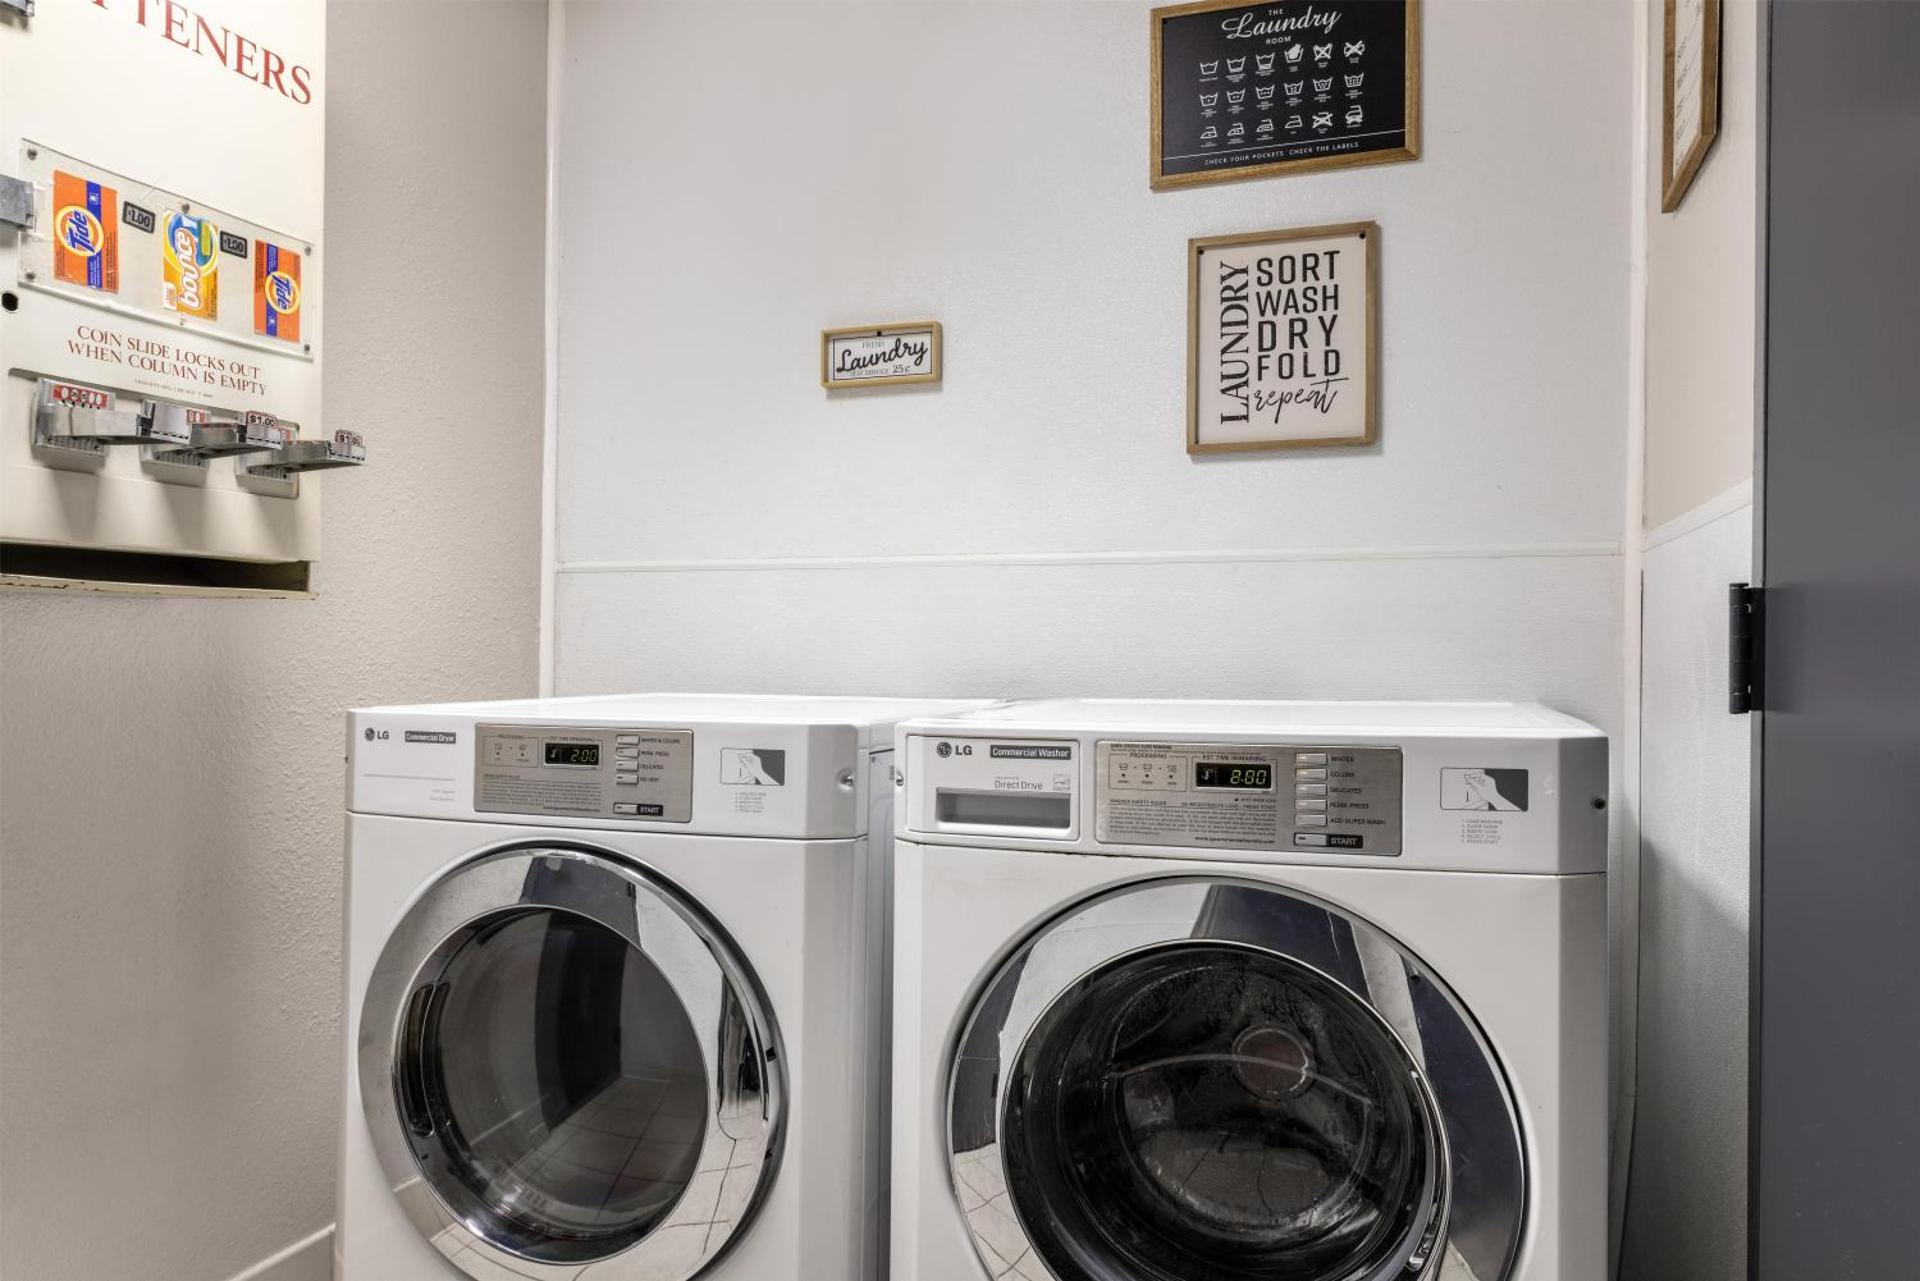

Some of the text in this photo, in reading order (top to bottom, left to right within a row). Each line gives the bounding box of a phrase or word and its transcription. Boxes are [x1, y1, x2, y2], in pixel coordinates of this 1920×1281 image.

[1221, 5, 1342, 39] Laundry
[1267, 8, 1284, 16] THE
[1265, 36, 1292, 45] ROOM
[1204, 141, 1360, 165] CHECK YOUR POCKETS CHECK THE LABELS
[68, 209, 96, 254] Tide
[176, 228, 201, 310] bounce
[1256, 250, 1340, 287] SORT
[271, 273, 293, 311] Tide
[1255, 284, 1339, 318] WASH
[1219, 261, 1249, 425] LAUNDRY
[1257, 314, 1338, 353] DRY
[67, 339, 123, 364] WHEN
[128, 353, 199, 383] COLUMN
[203, 371, 216, 385] IS
[220, 374, 268, 396] EMPTY
[77, 325, 261, 380] COIN SLIDE LOCKS OUT
[836, 337, 929, 374] Laundry
[1257, 349, 1341, 381] FOLD
[1253, 376, 1350, 424] repeat
[249, 415, 276, 427] $1.00
[992, 747, 1037, 758] Commercial
[1038, 748, 1070, 758] Washer
[994, 780, 1043, 790] Direct Drive
